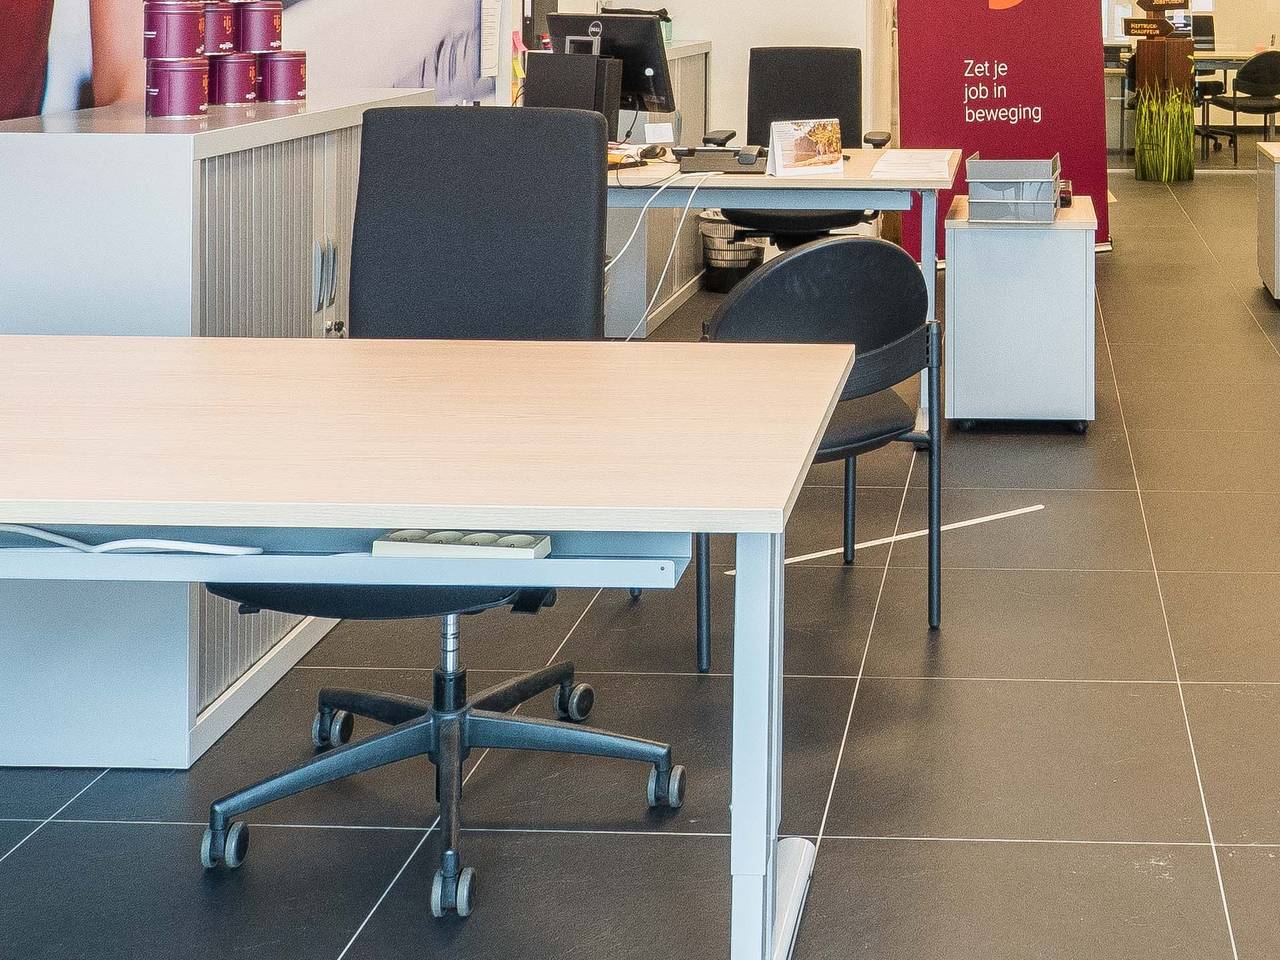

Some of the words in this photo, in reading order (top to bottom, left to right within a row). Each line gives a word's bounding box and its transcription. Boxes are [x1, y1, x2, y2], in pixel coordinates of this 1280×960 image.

[964, 60, 990, 77] Zet
[992, 60, 1008, 80] je
[963, 83, 989, 103] job
[993, 82, 1007, 99] in
[965, 104, 1042, 125] beweging
